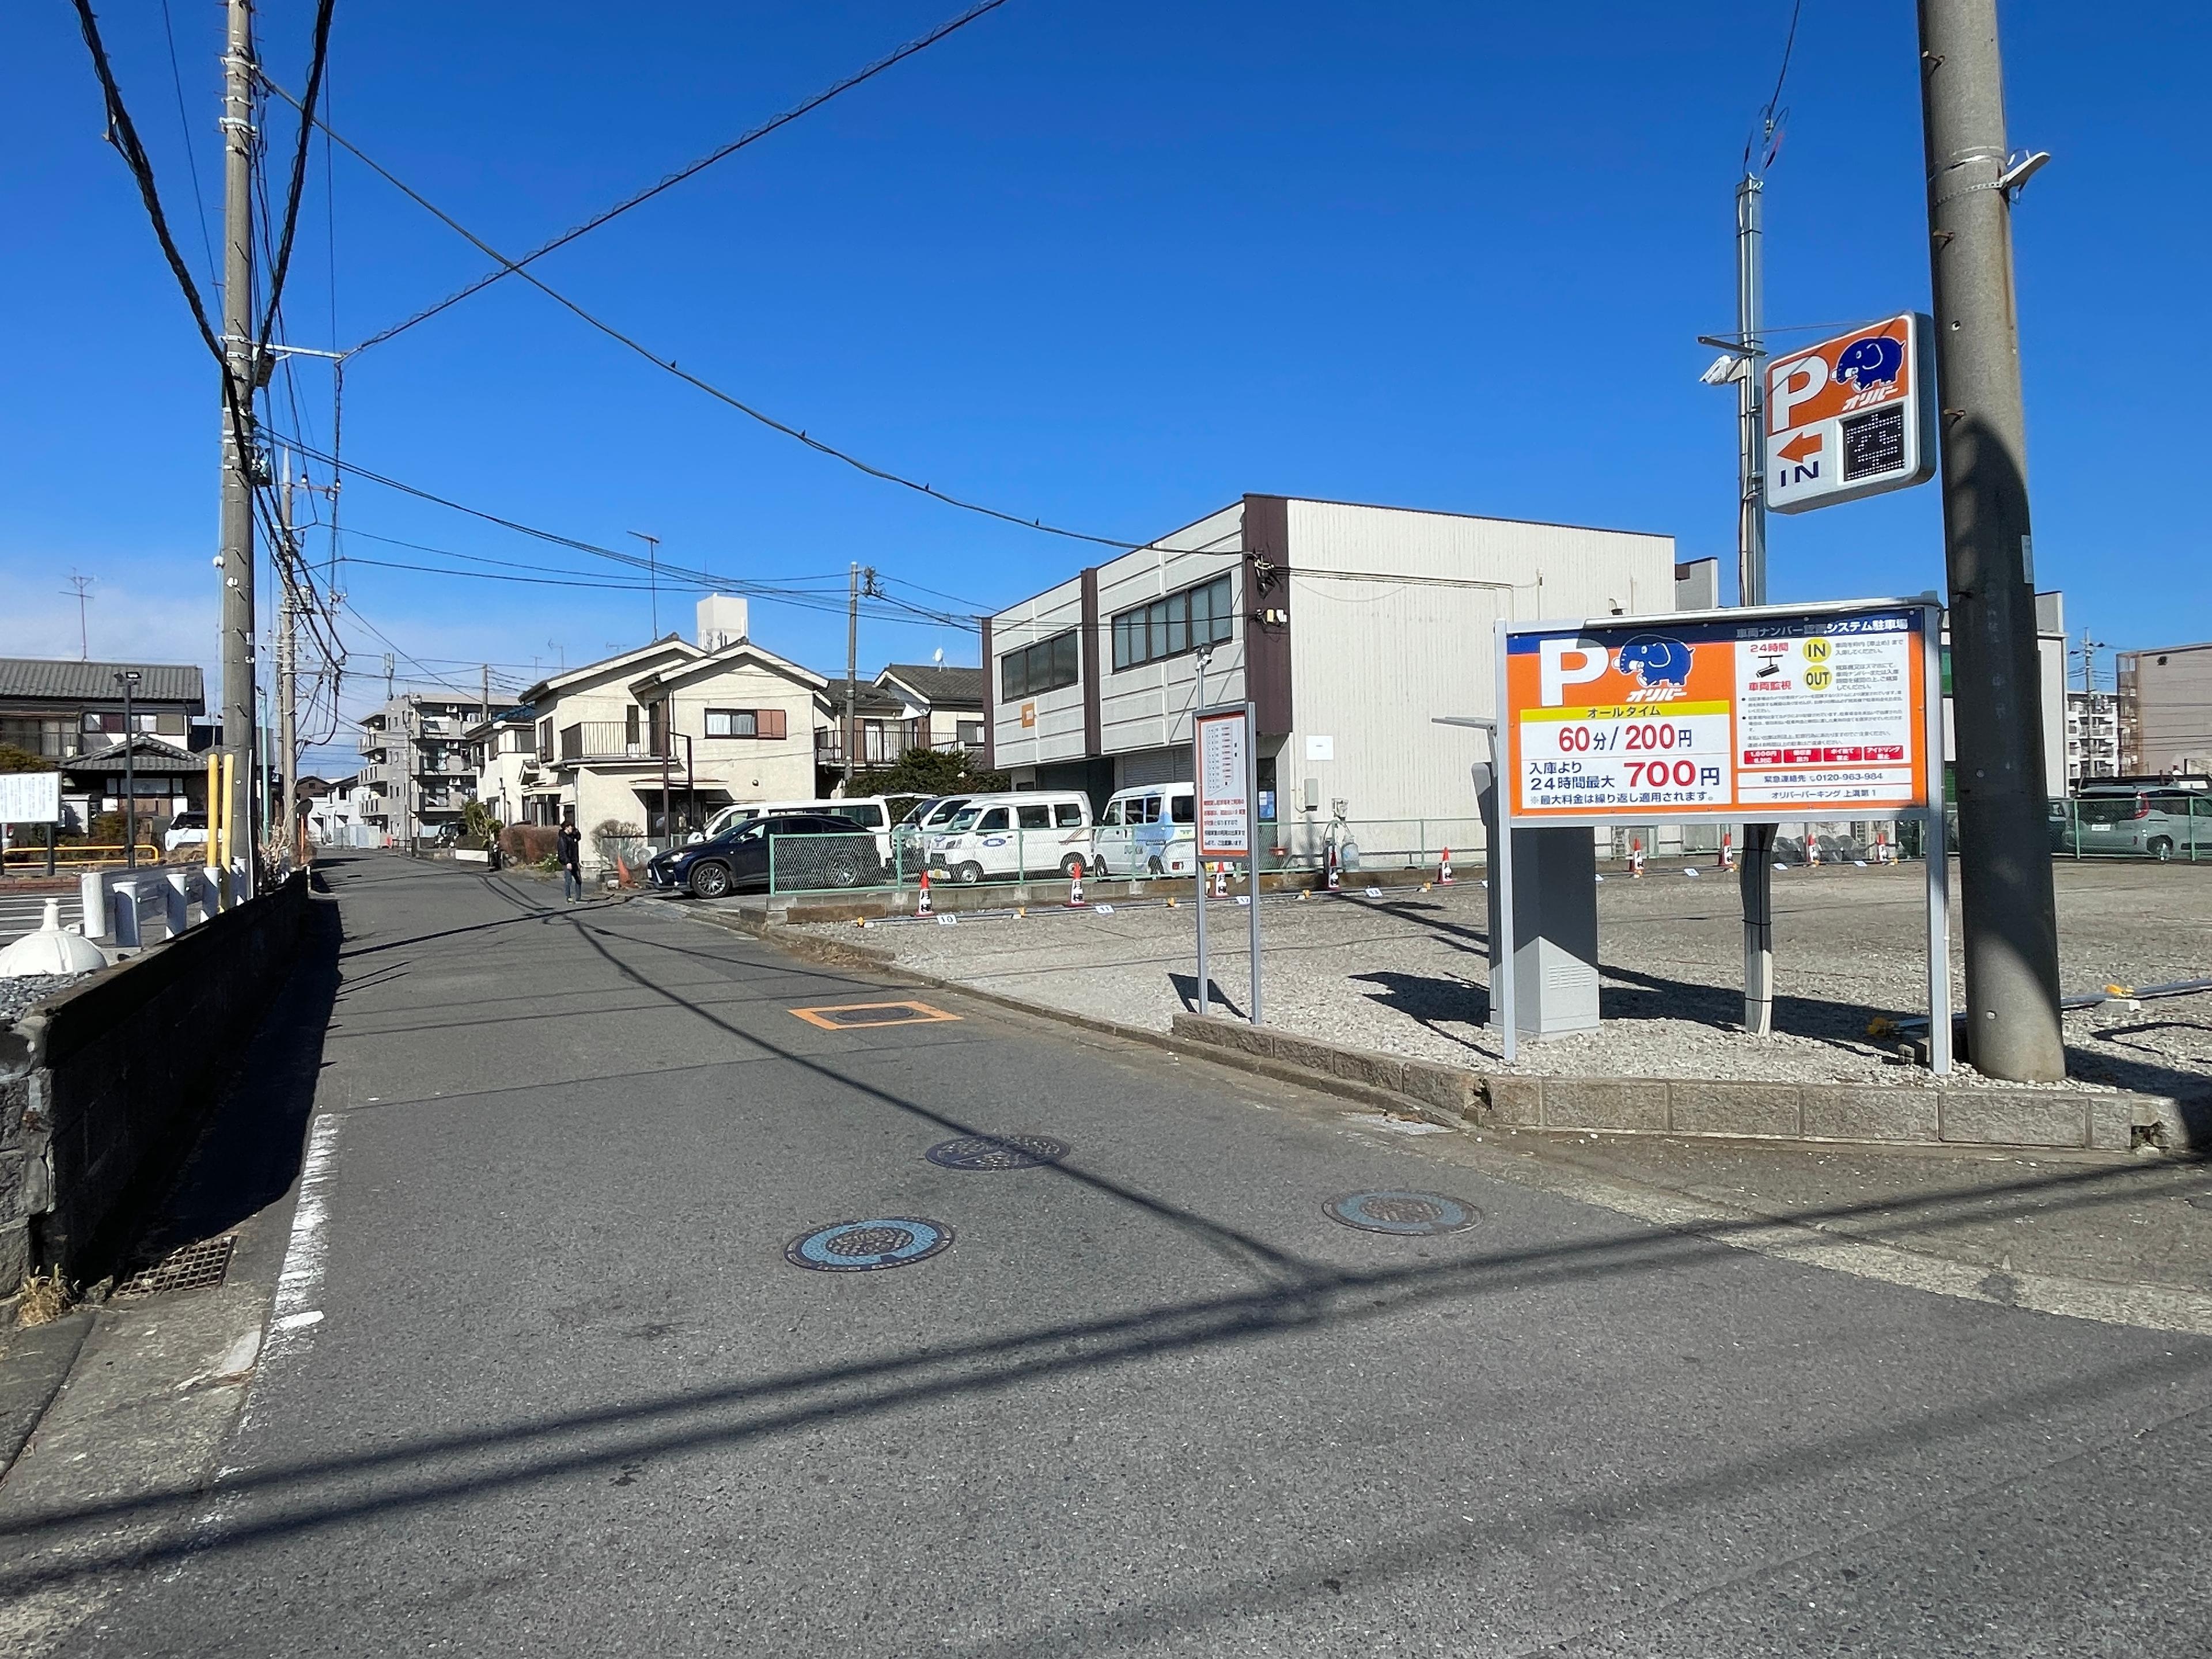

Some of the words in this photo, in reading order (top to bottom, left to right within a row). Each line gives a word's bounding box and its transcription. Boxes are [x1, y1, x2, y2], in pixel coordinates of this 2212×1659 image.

[1772, 355, 1829, 434] P
[1841, 385, 1899, 412] オリバー
[1781, 461, 1819, 487] IN
[1750, 642, 1789, 653] 24時間
[1808, 643, 1825, 658] IN
[1540, 638, 1609, 707] P
[1806, 672, 1830, 686] OUT
[1626, 688, 1688, 702] オリバー
[1588, 706, 1661, 718] オールタイム
[1529, 761, 1582, 775] 入庫より
[1531, 775, 1615, 790] 24時間最大
[1623, 759, 1720, 788] 700円
